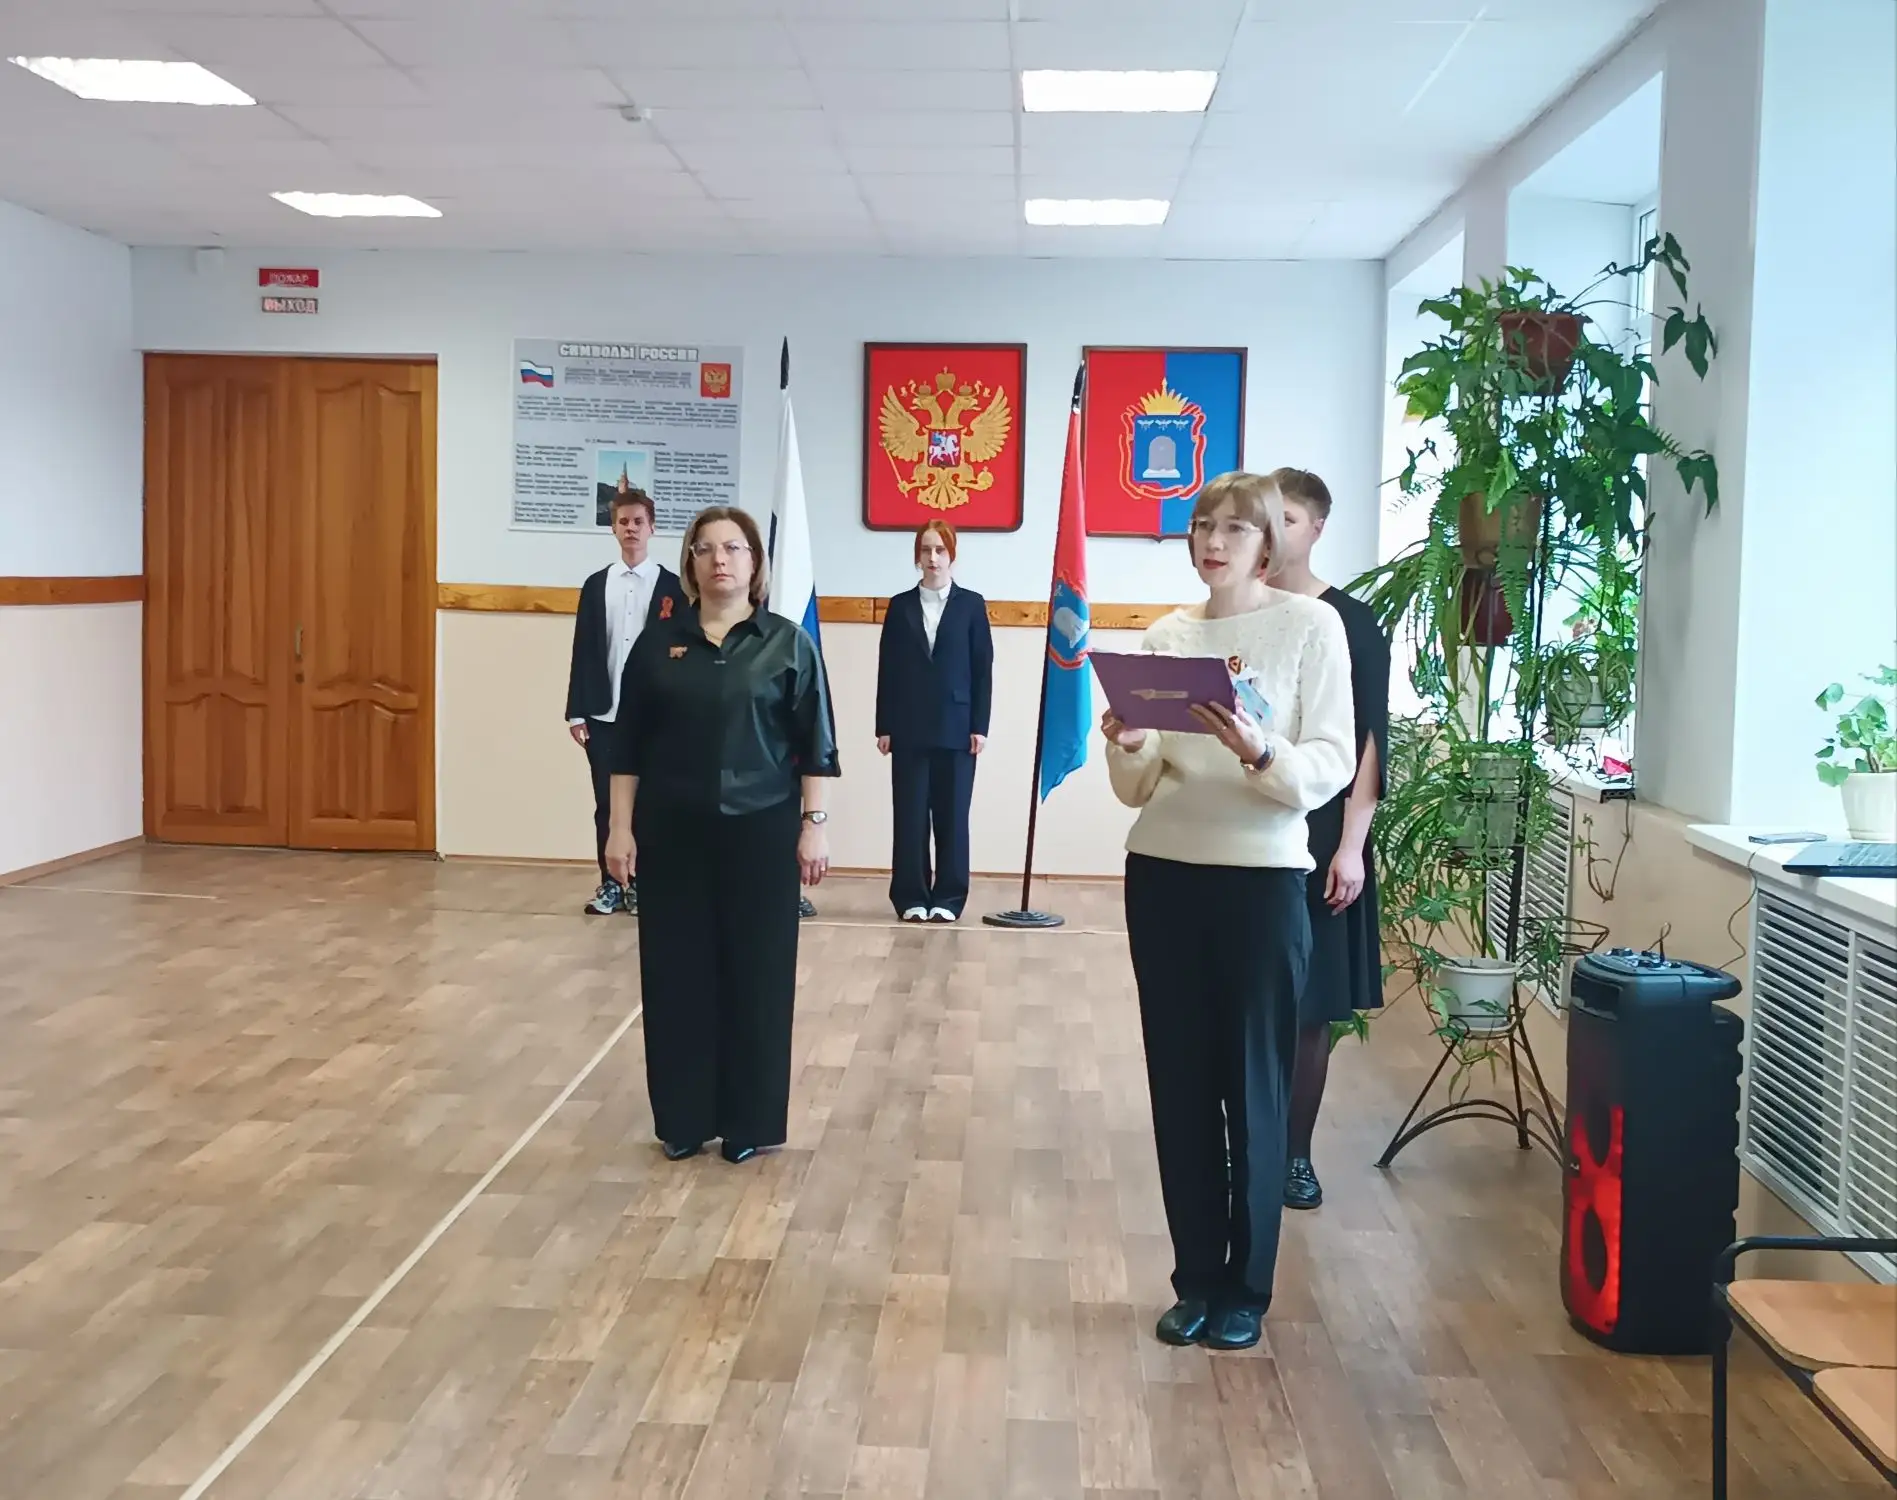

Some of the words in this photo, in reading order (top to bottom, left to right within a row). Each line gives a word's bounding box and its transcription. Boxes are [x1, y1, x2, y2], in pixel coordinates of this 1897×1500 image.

[268, 272, 309, 284] ПОЖАР
[264, 298, 316, 313] ВЫХОД
[559, 343, 635, 359] СИМВОЛЫ
[639, 347, 699, 362] РОССИИ
